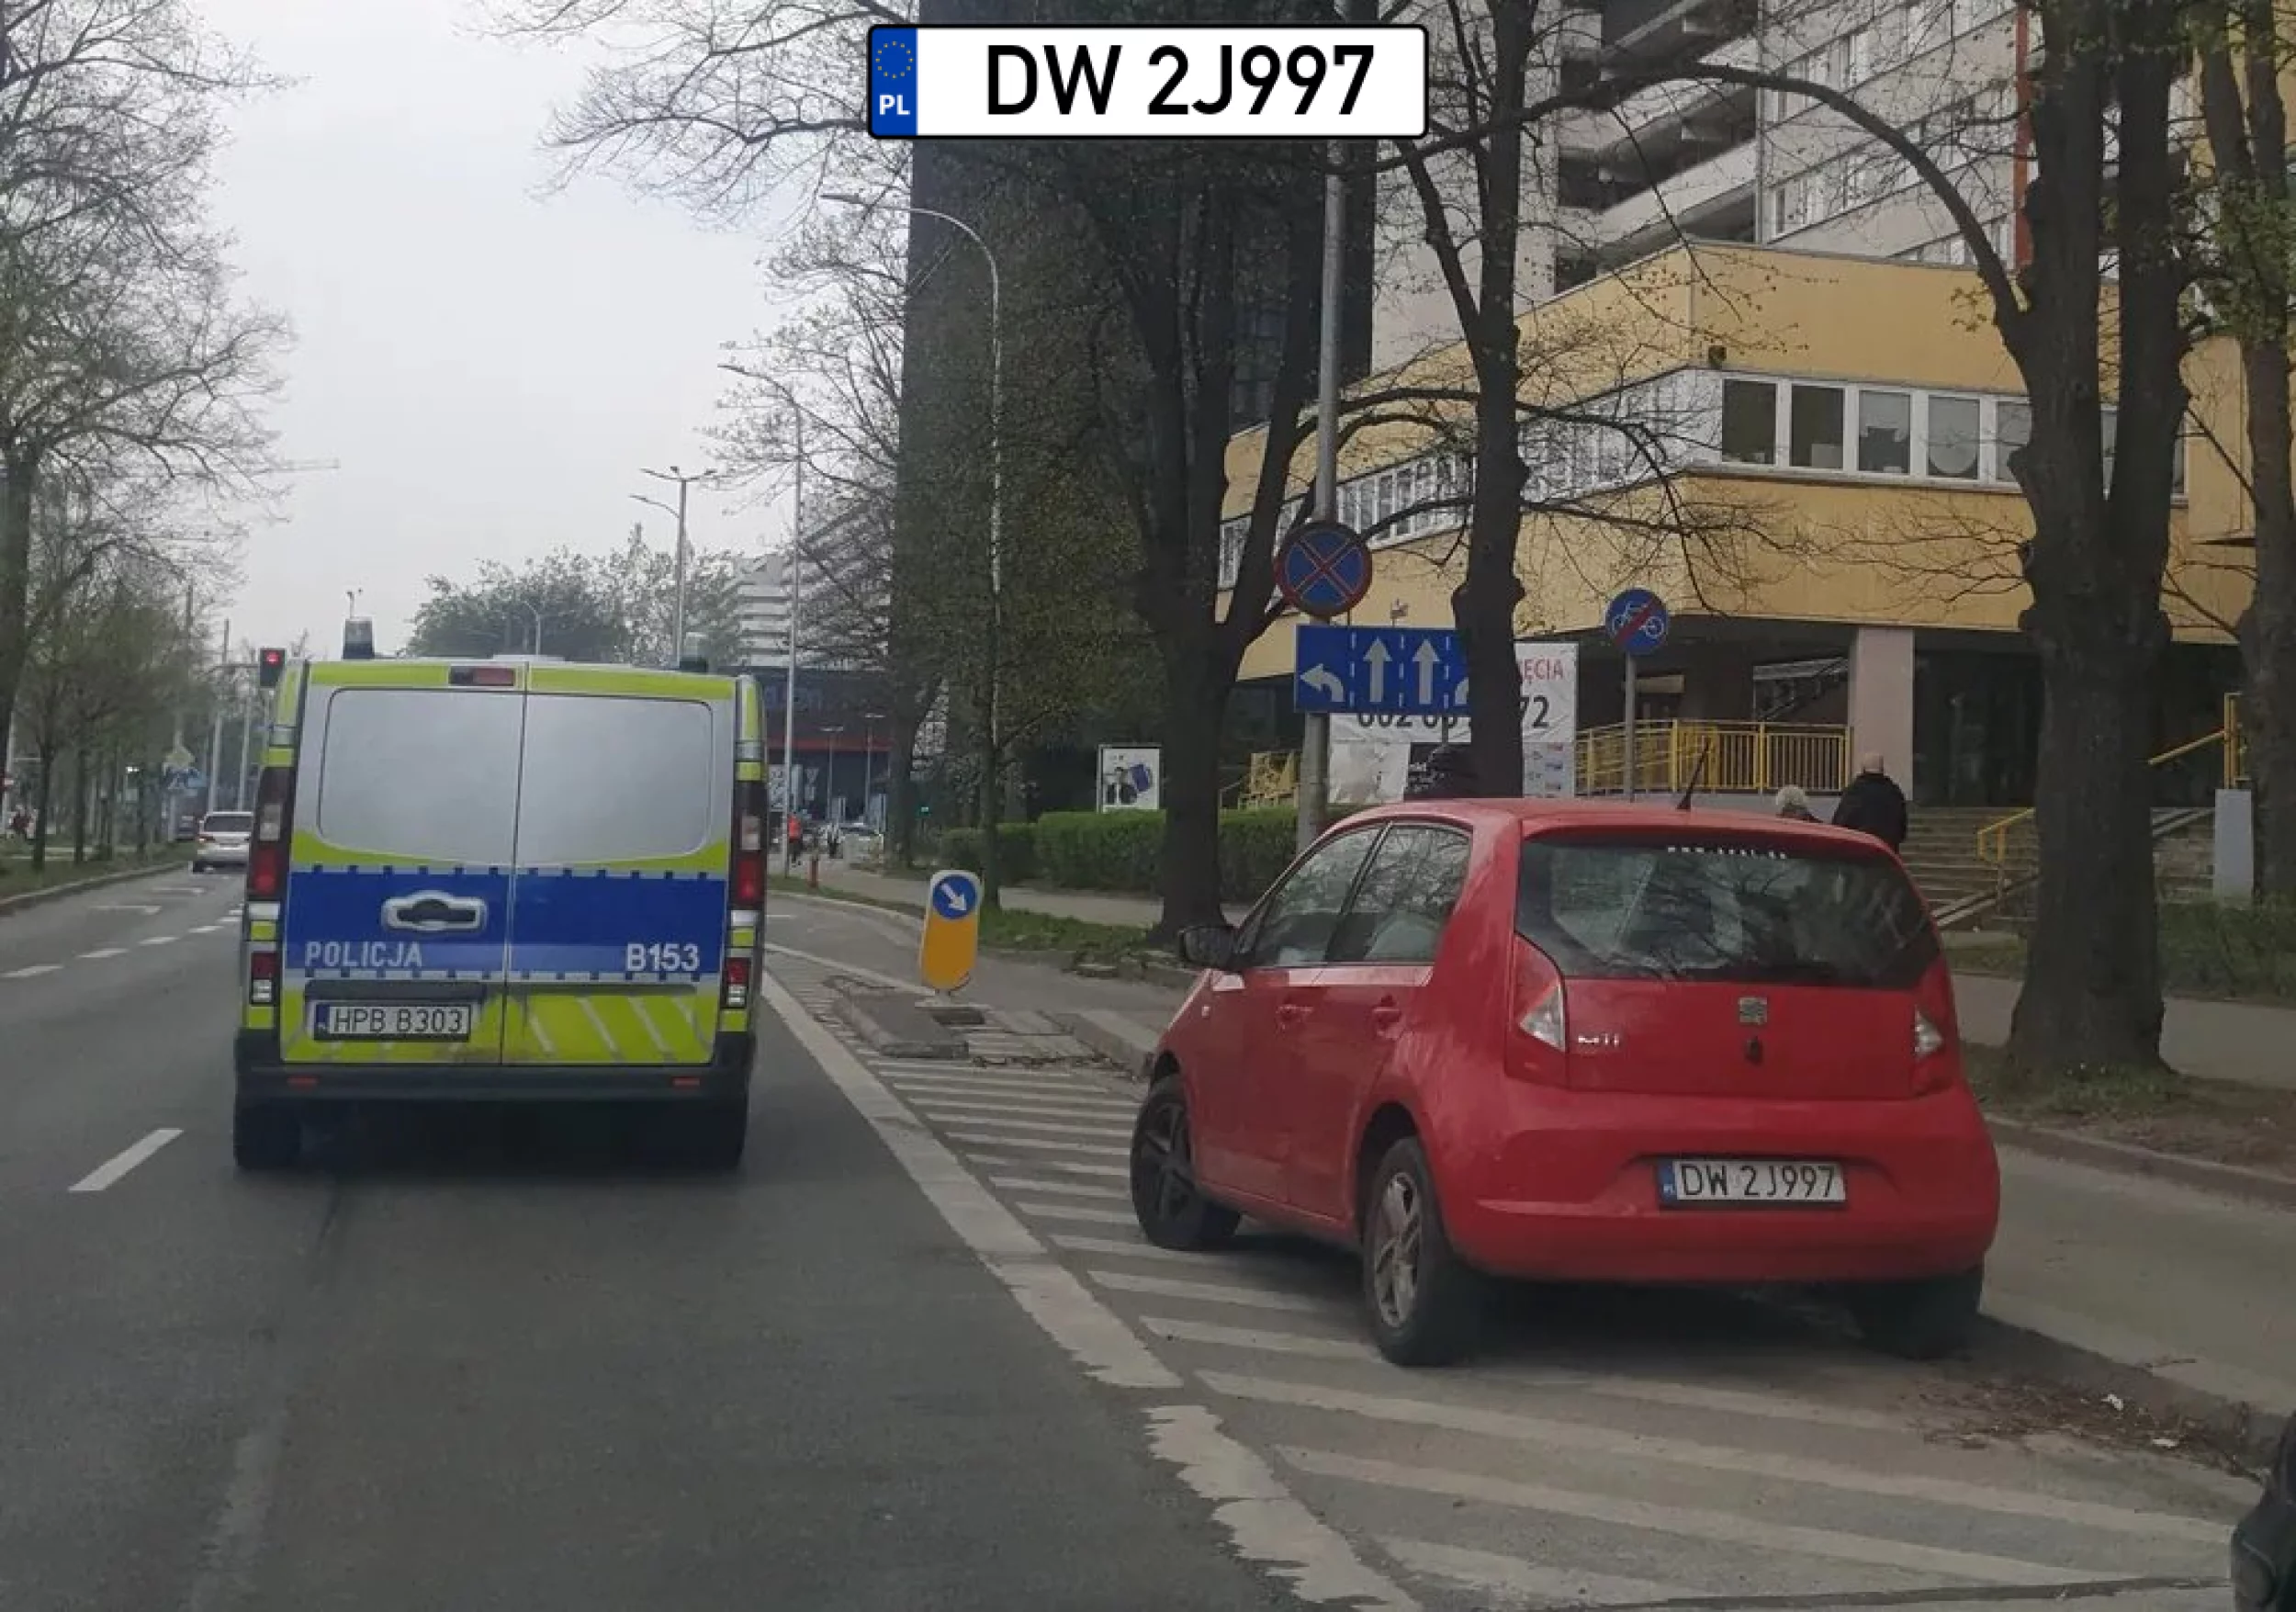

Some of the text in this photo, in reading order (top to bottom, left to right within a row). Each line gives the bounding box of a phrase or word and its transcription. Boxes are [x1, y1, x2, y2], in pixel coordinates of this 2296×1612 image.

[305, 941, 422, 968] POLICJA
[625, 943, 700, 971] B153
[333, 1008, 463, 1032] HPB B303
[1680, 1164, 1836, 1198] DW 2J997
